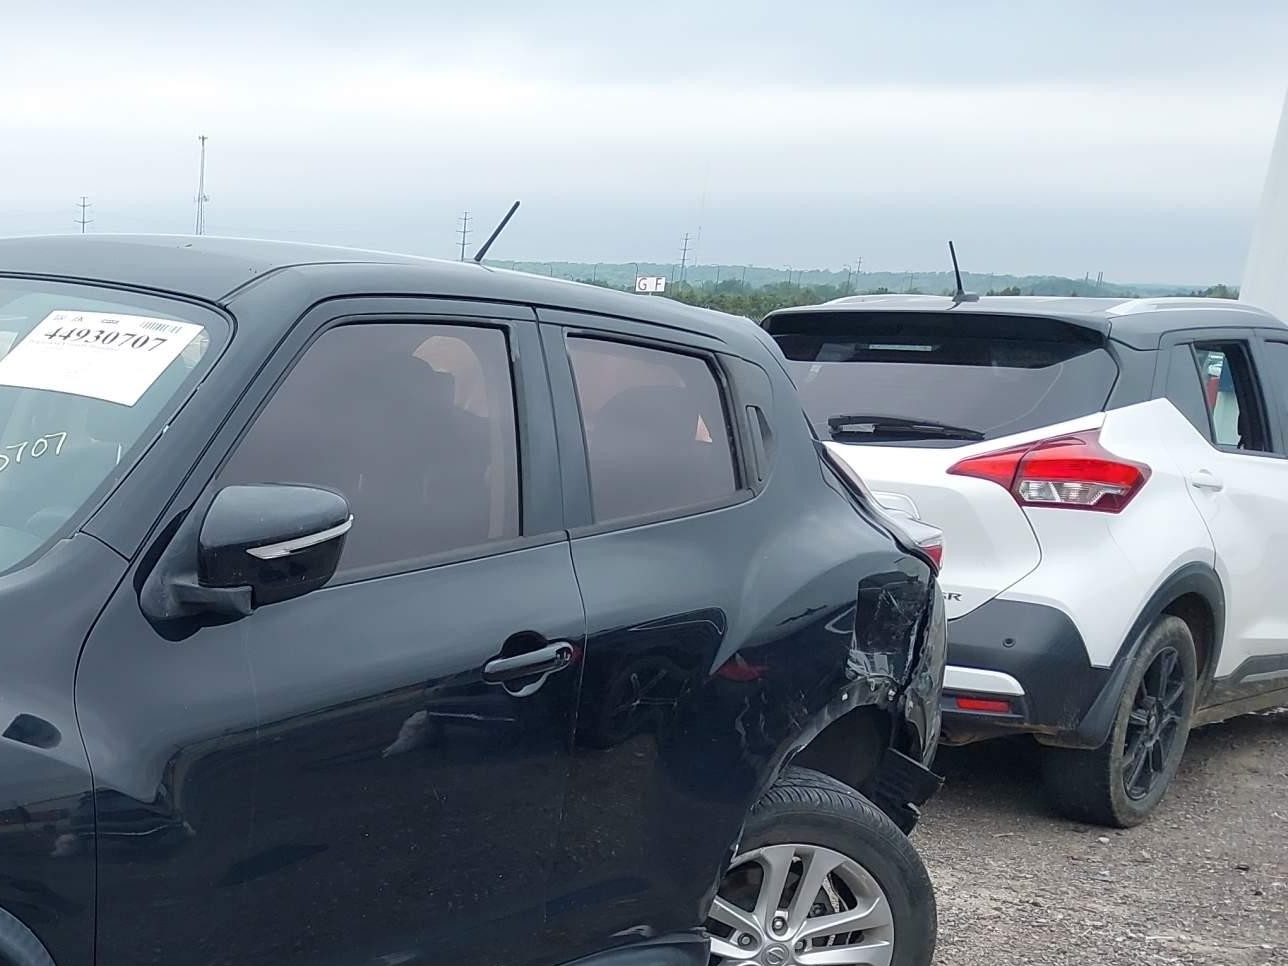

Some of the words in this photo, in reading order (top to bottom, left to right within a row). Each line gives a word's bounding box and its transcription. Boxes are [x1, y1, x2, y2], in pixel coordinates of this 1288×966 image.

[638, 278, 648, 291] G
[655, 278, 663, 291] F
[45, 327, 168, 351] 44930707
